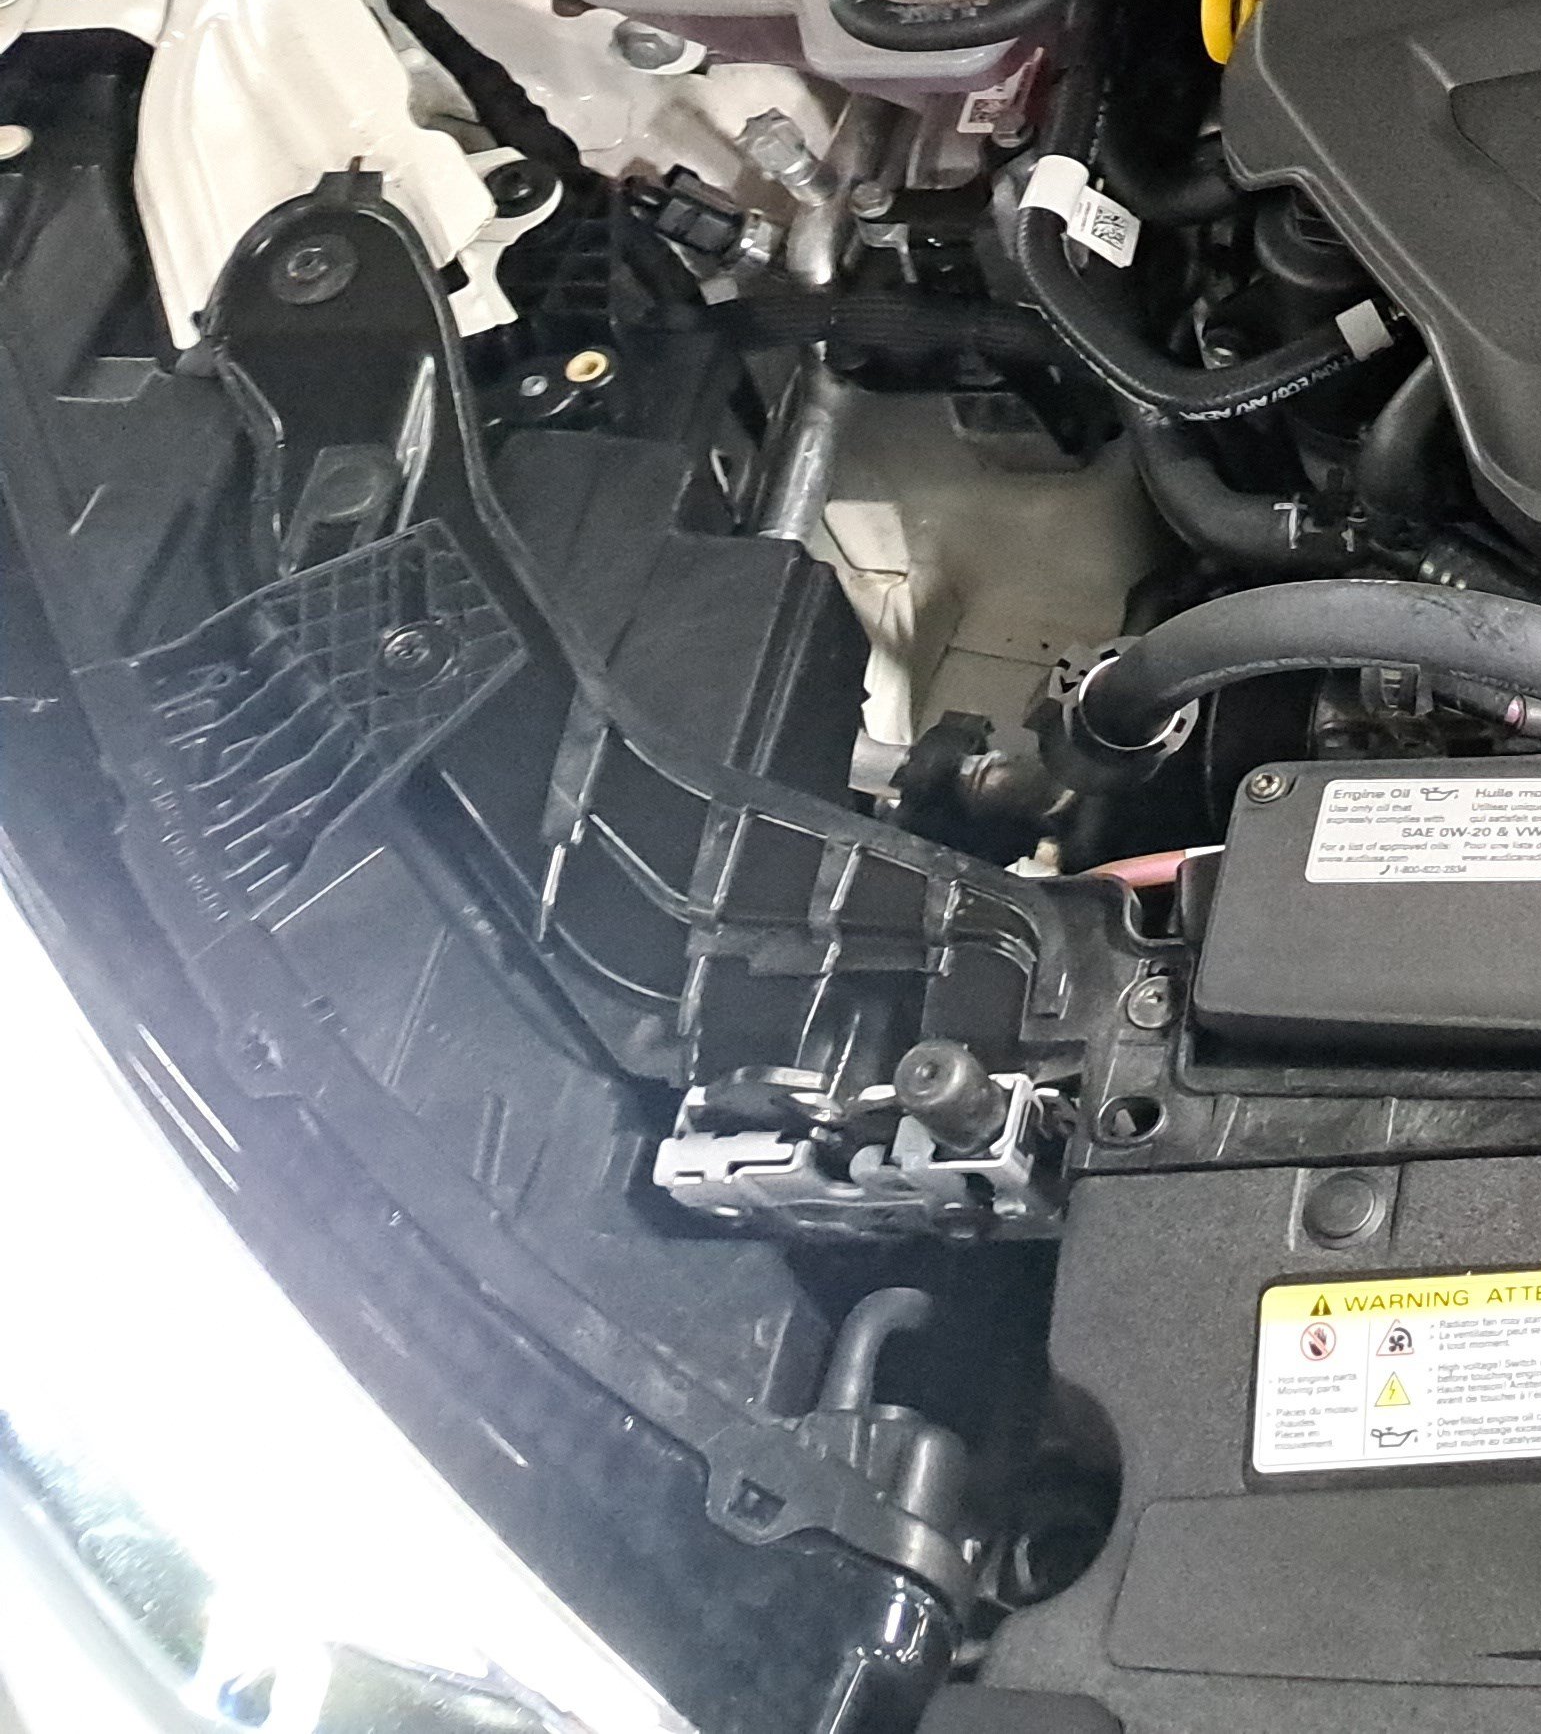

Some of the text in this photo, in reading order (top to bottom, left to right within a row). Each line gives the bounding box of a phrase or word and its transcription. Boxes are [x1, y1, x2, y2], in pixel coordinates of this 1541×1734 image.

[1333, 788, 1411, 801] Engine Oil
[1475, 788, 1514, 798] Huile
[1402, 827, 1435, 837] SAE
[1439, 827, 1491, 838] 0W-20
[1496, 827, 1509, 837] &
[1342, 1288, 1469, 1313] WARNING
